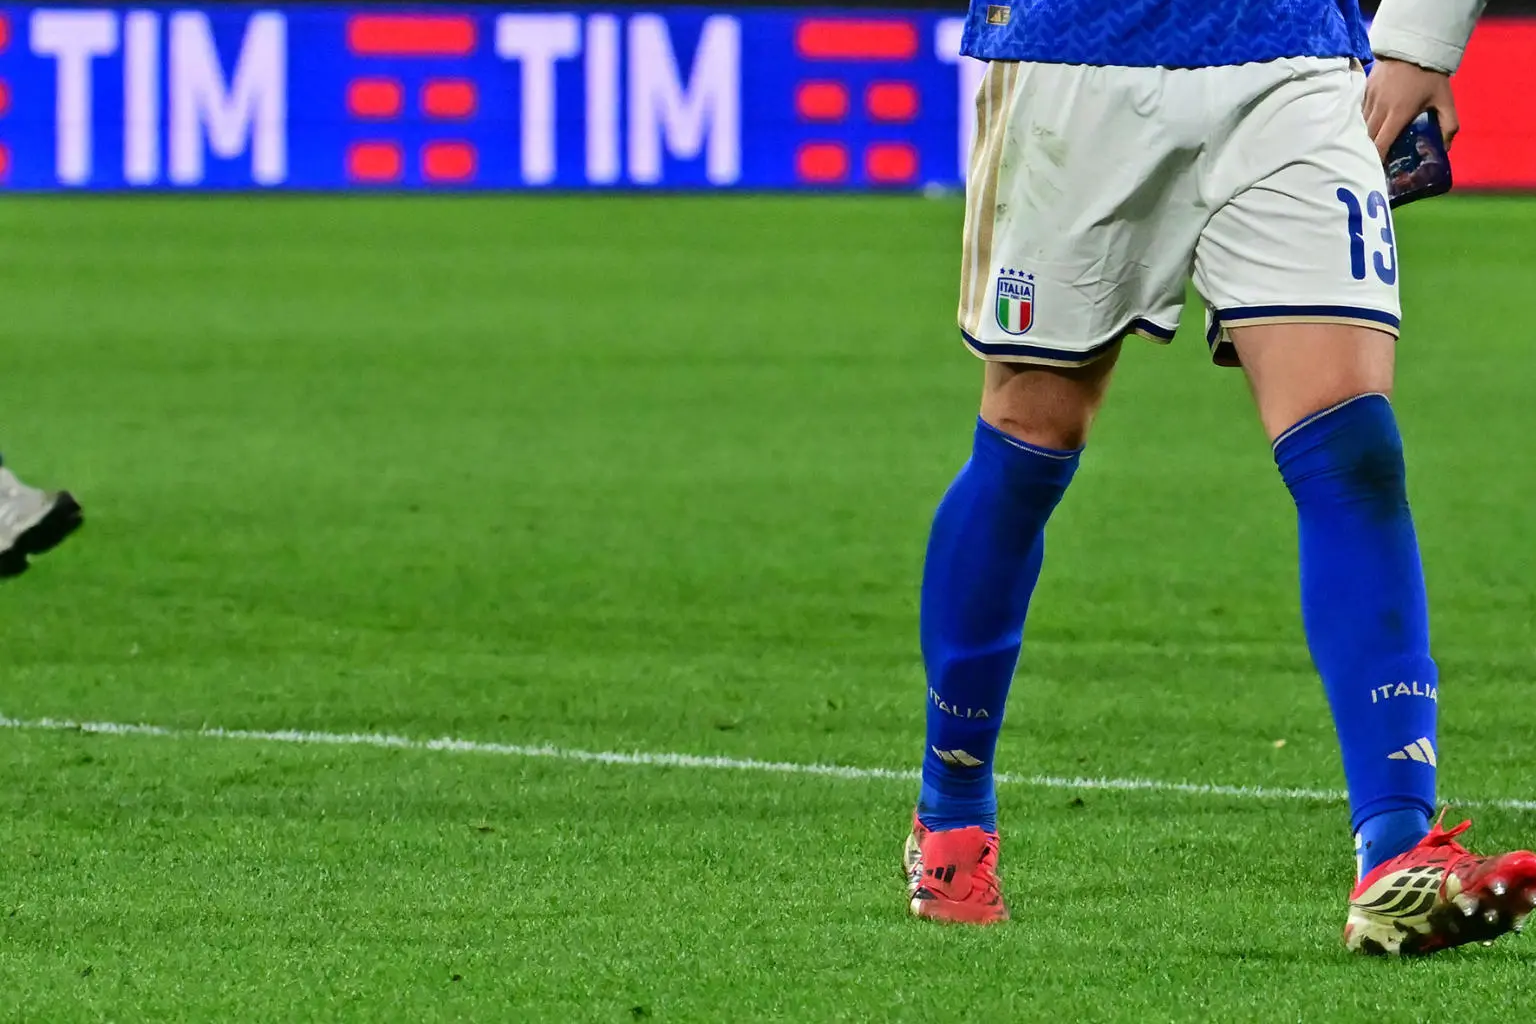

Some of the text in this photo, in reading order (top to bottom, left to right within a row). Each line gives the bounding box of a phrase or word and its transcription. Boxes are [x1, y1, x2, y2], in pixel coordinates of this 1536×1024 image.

[29, 10, 288, 187] TIM
[496, 12, 742, 187] TIM
[1336, 187, 1397, 286] 13
[1000, 281, 1031, 297] ITALIA
[929, 686, 989, 718] ITALIA
[1371, 680, 1438, 704] ITALIA
